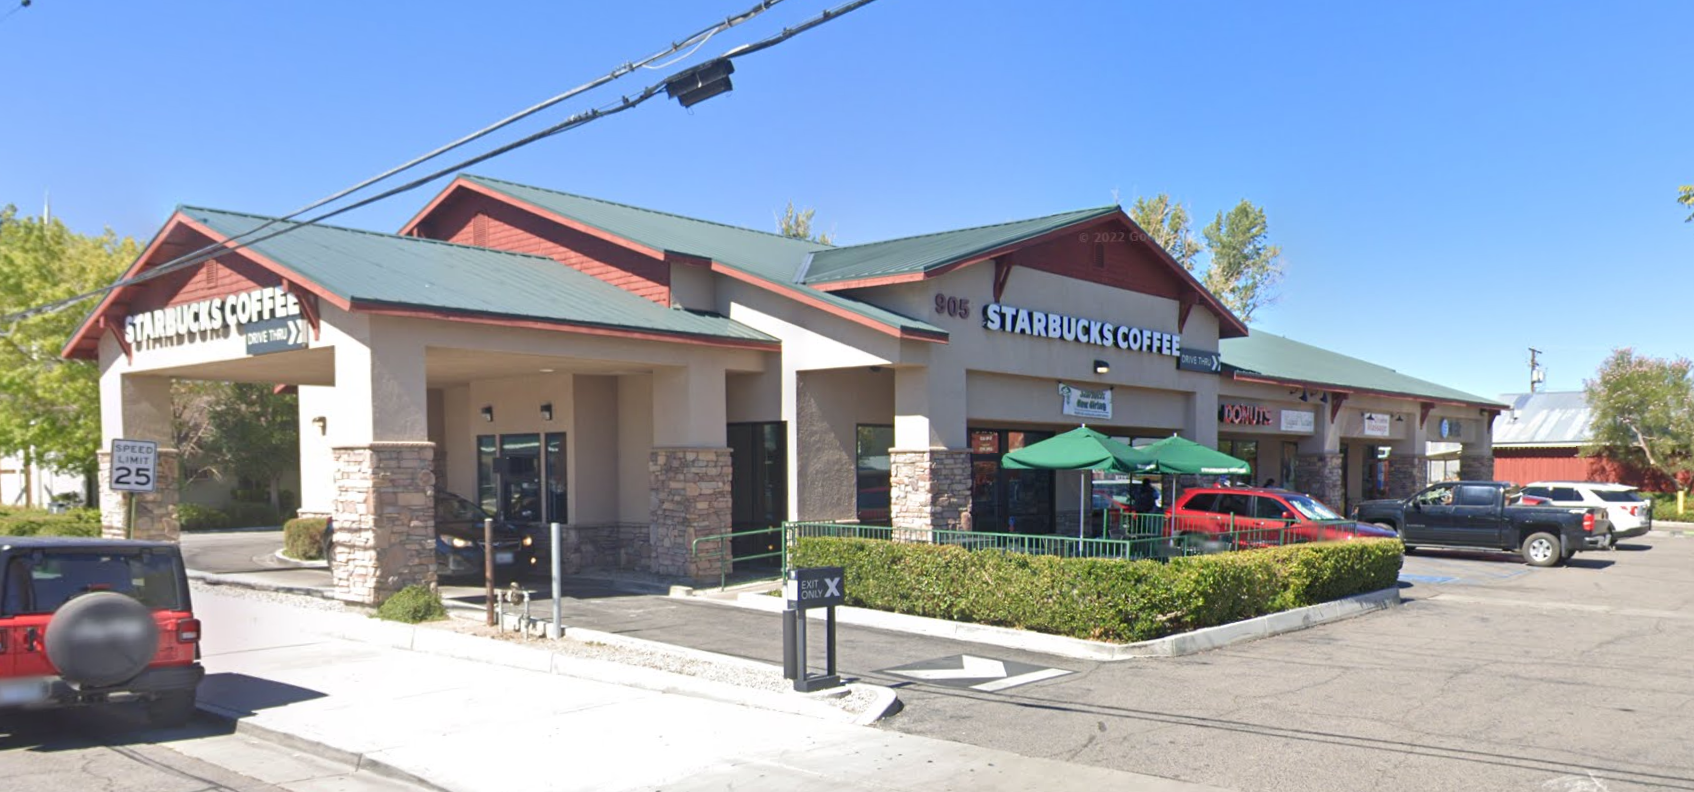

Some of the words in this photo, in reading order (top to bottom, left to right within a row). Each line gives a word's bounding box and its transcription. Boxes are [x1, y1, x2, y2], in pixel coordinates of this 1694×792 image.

[124, 297, 223, 344] STARBUCKS
[225, 286, 300, 325] COFFEE
[934, 293, 970, 319] 905
[247, 330, 268, 345] DRIVE
[269, 327, 288, 342] THRU
[985, 304, 1113, 347] STARBUCKS
[1116, 325, 1181, 357] COFFEE
[1181, 354, 1197, 365] DRIVE
[1198, 356, 1212, 367] THRU
[1224, 403, 1272, 426] DONUTS
[115, 444, 154, 455] SPEED
[117, 456, 150, 465] LIMIT
[114, 466, 151, 486] 25
[801, 579, 819, 590] EXIT
[801, 589, 823, 600] ONLY
